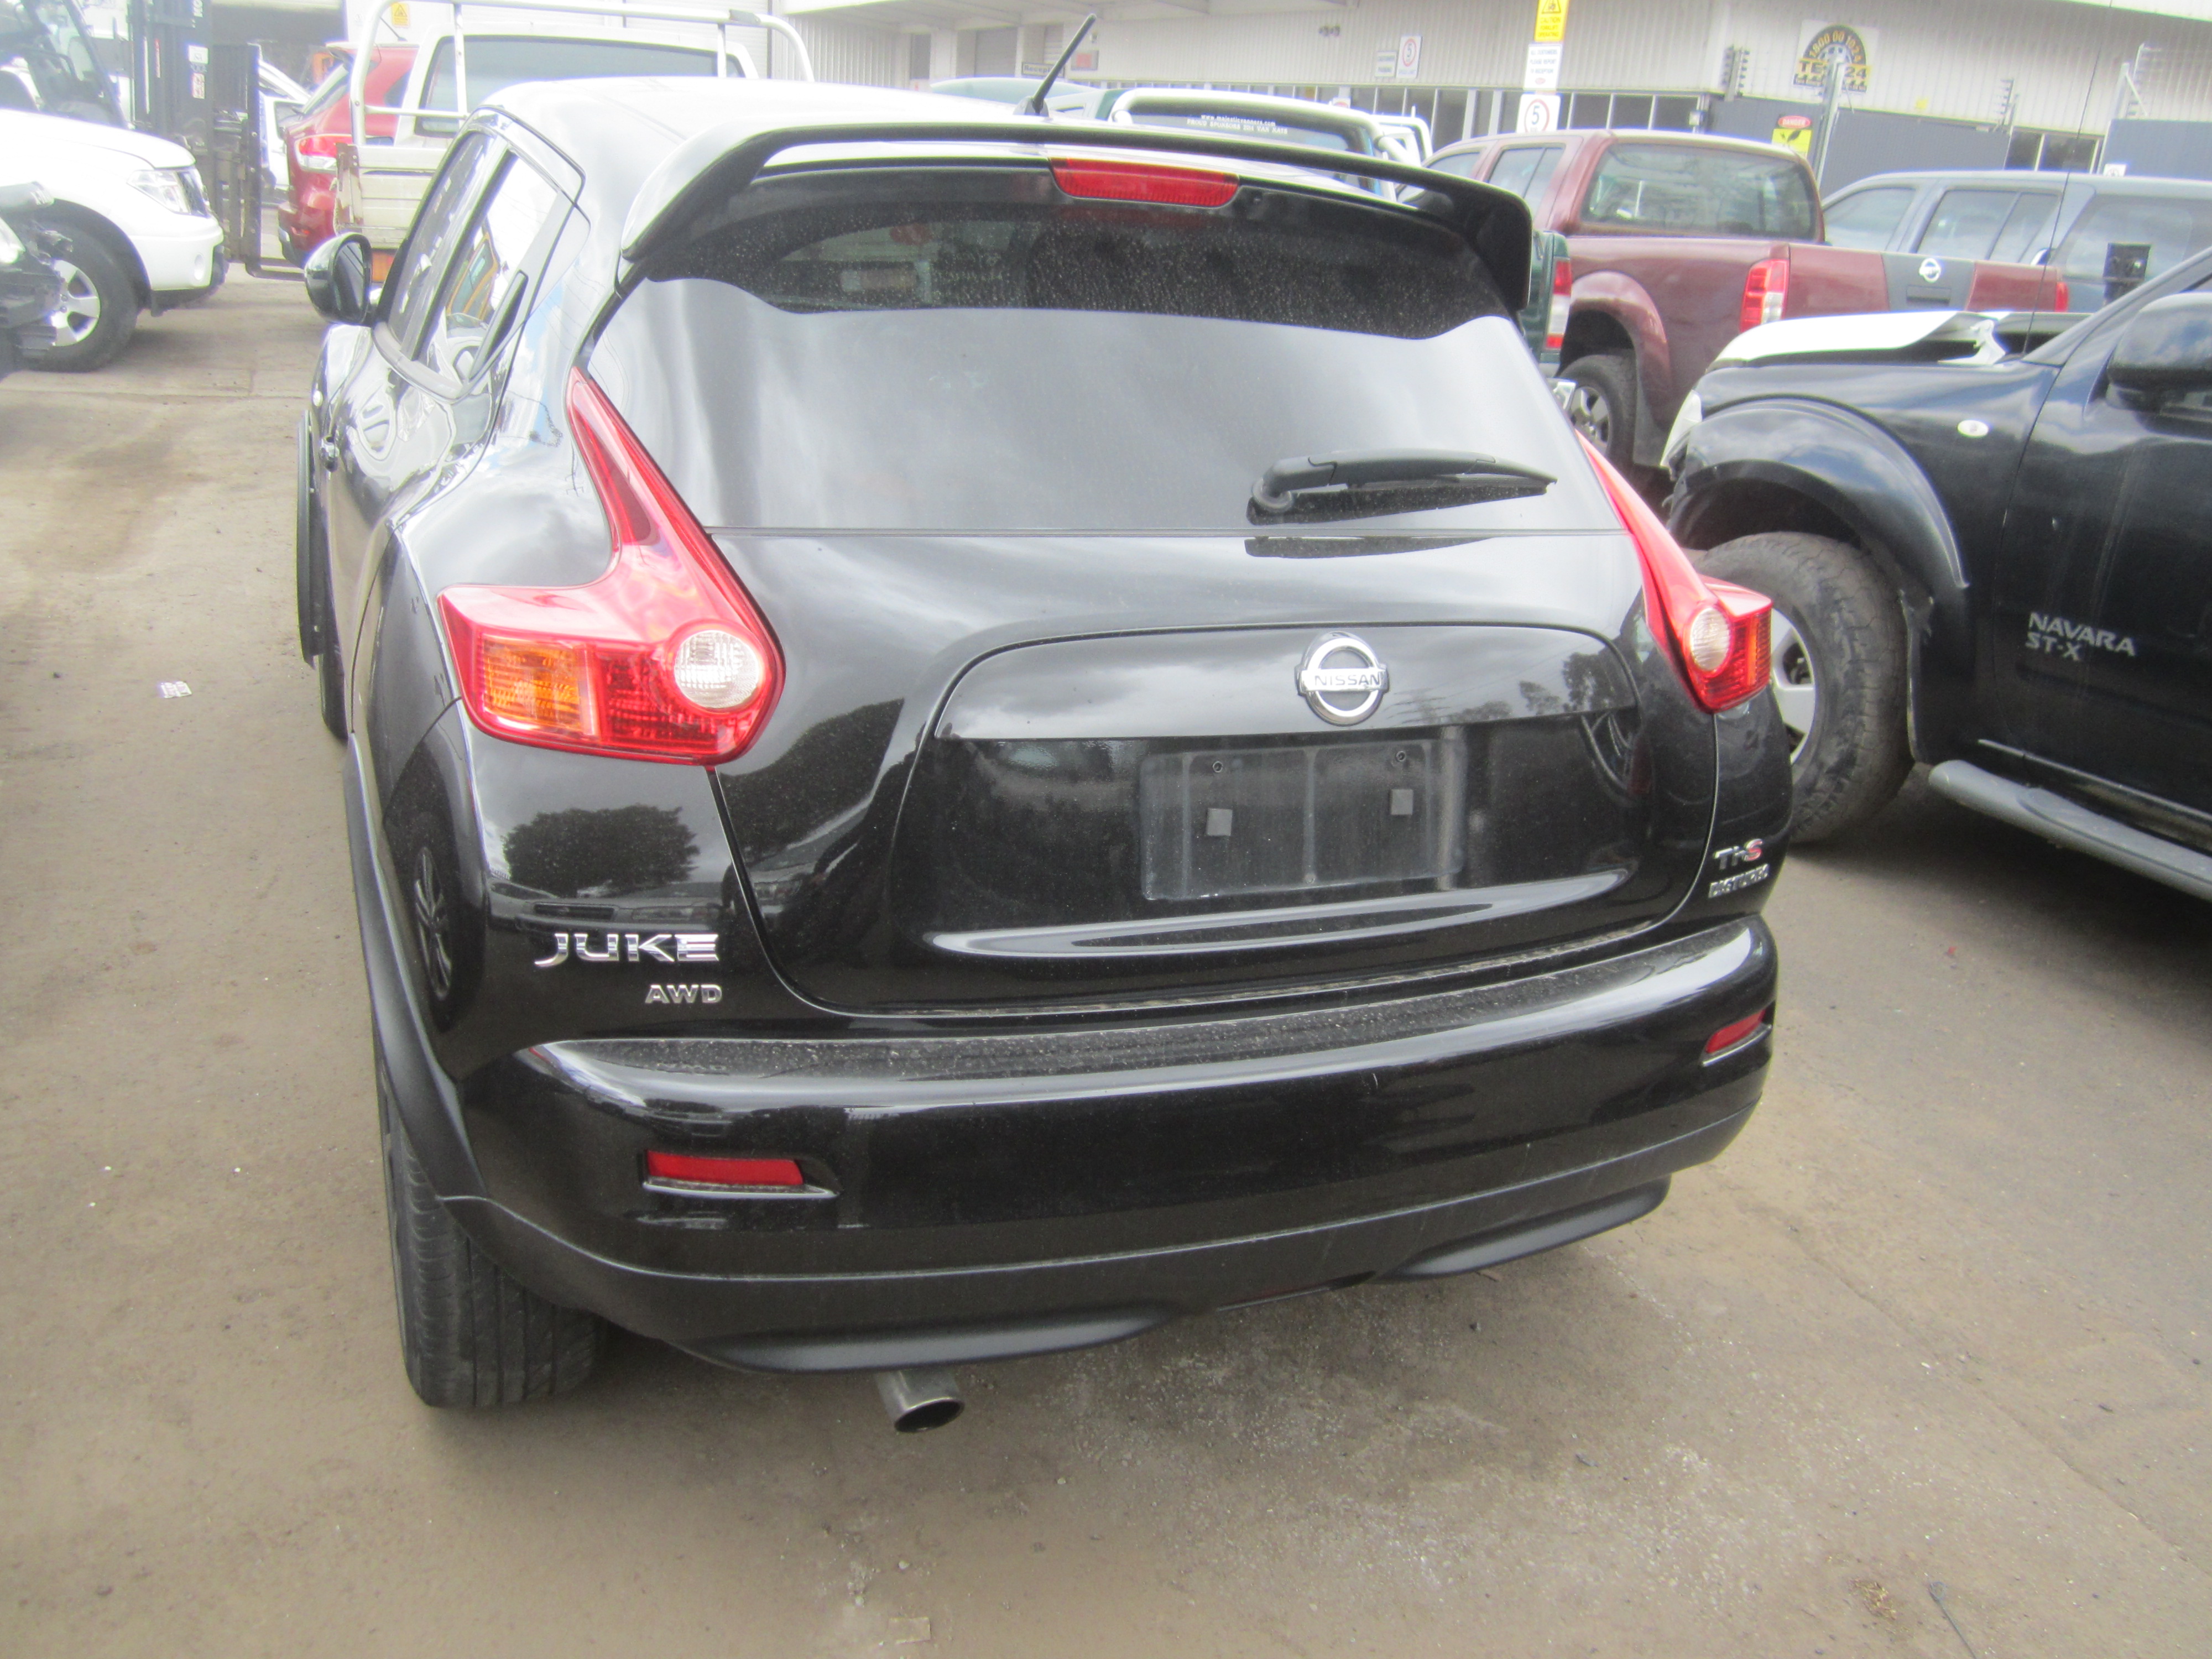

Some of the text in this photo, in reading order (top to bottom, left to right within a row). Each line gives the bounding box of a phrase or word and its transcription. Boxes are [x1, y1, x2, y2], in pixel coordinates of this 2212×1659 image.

[1407, 43, 1412, 58] 5
[1808, 33, 1830, 58] 1800
[1531, 105, 1540, 125] 5
[2028, 612, 2136, 656] NAVARA
[2025, 632, 2081, 661] ST-X
[1314, 674, 1380, 686] NISSAN
[534, 933, 719, 967] JUKE
[644, 984, 722, 1004] AWD
